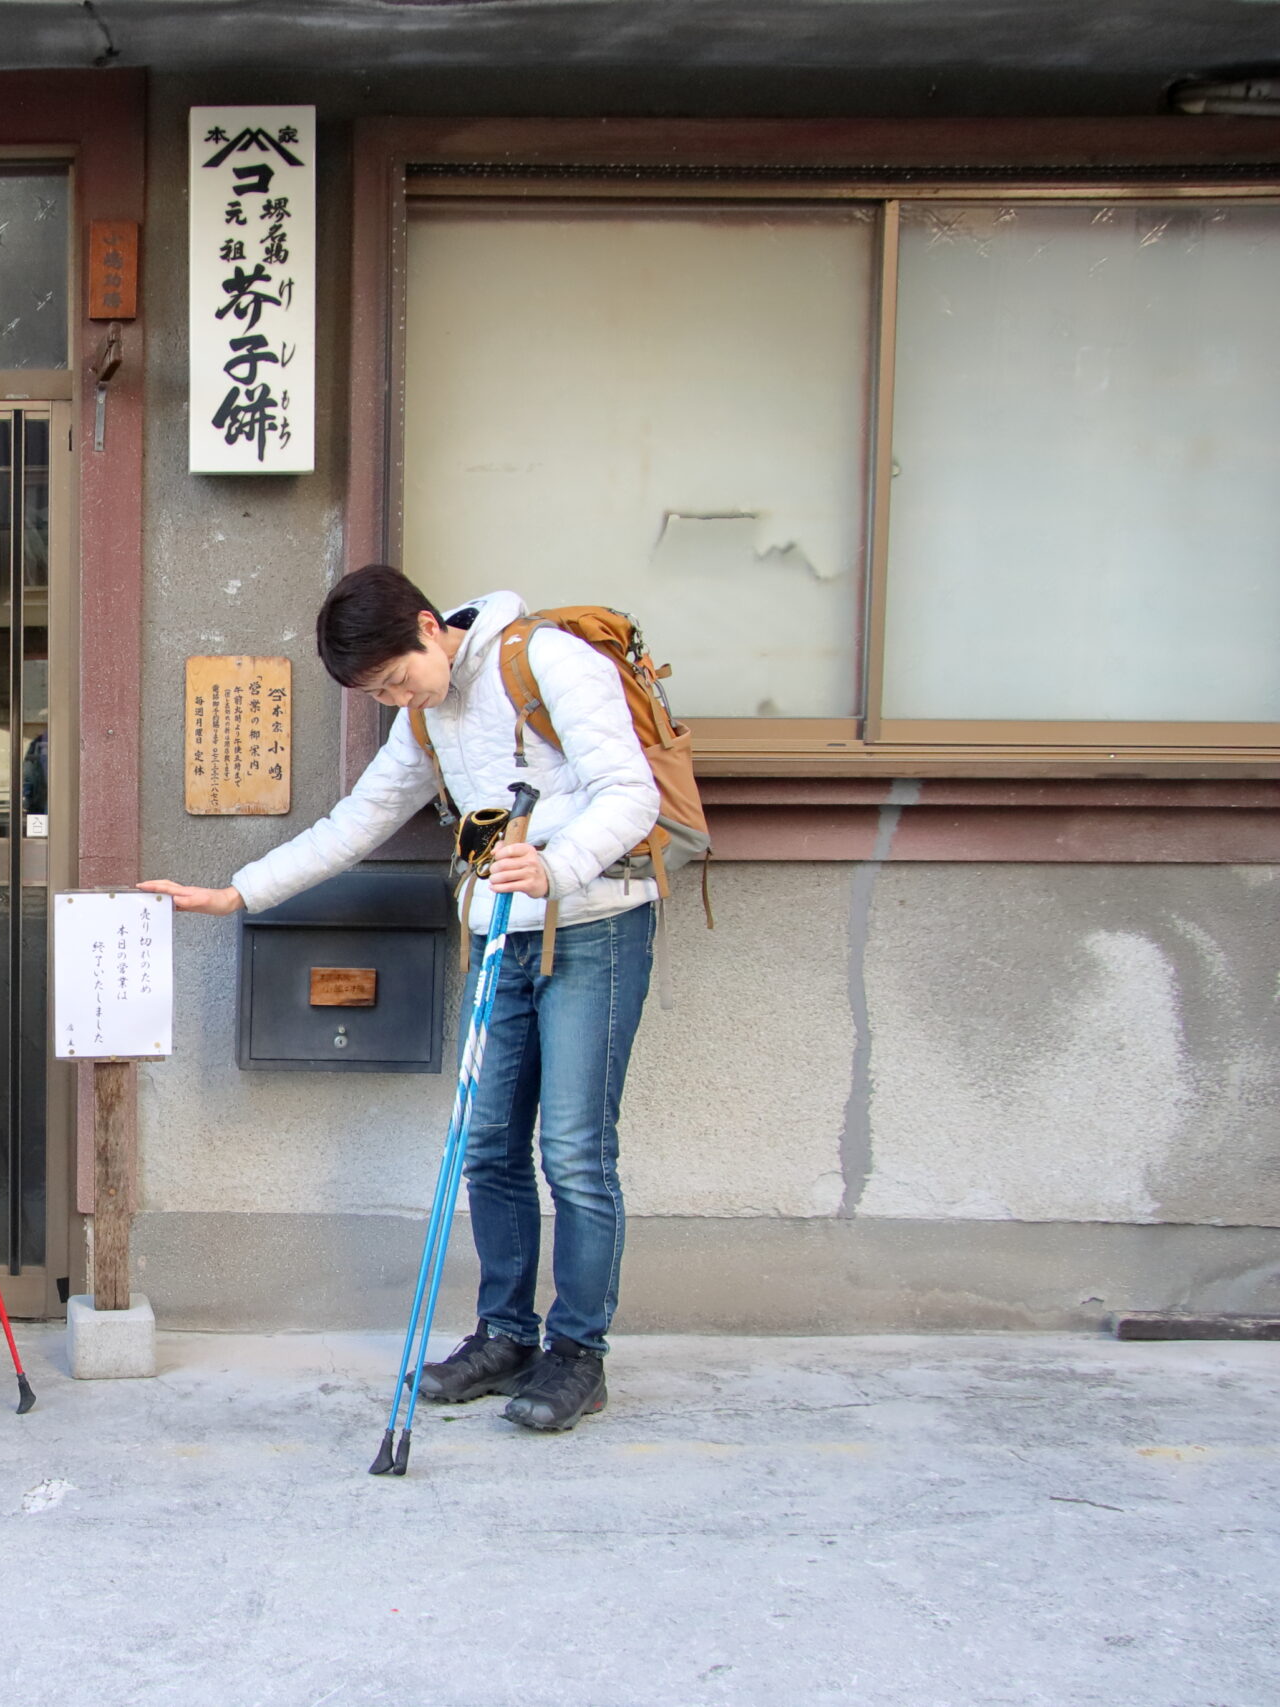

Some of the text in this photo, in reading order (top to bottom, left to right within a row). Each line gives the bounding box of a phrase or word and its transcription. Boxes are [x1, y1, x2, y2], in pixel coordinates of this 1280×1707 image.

[204, 126, 299, 144] 本 家
[219, 200, 247, 262] 元祖
[259, 197, 292, 264] 堺名物
[212, 265, 281, 462] 芥子餅
[277, 276, 297, 451] けしもち
[116, 924, 129, 1001] 本日の営業は
[139, 907, 152, 995] 売り切れのため
[92, 941, 106, 1044] 終了いたしました
